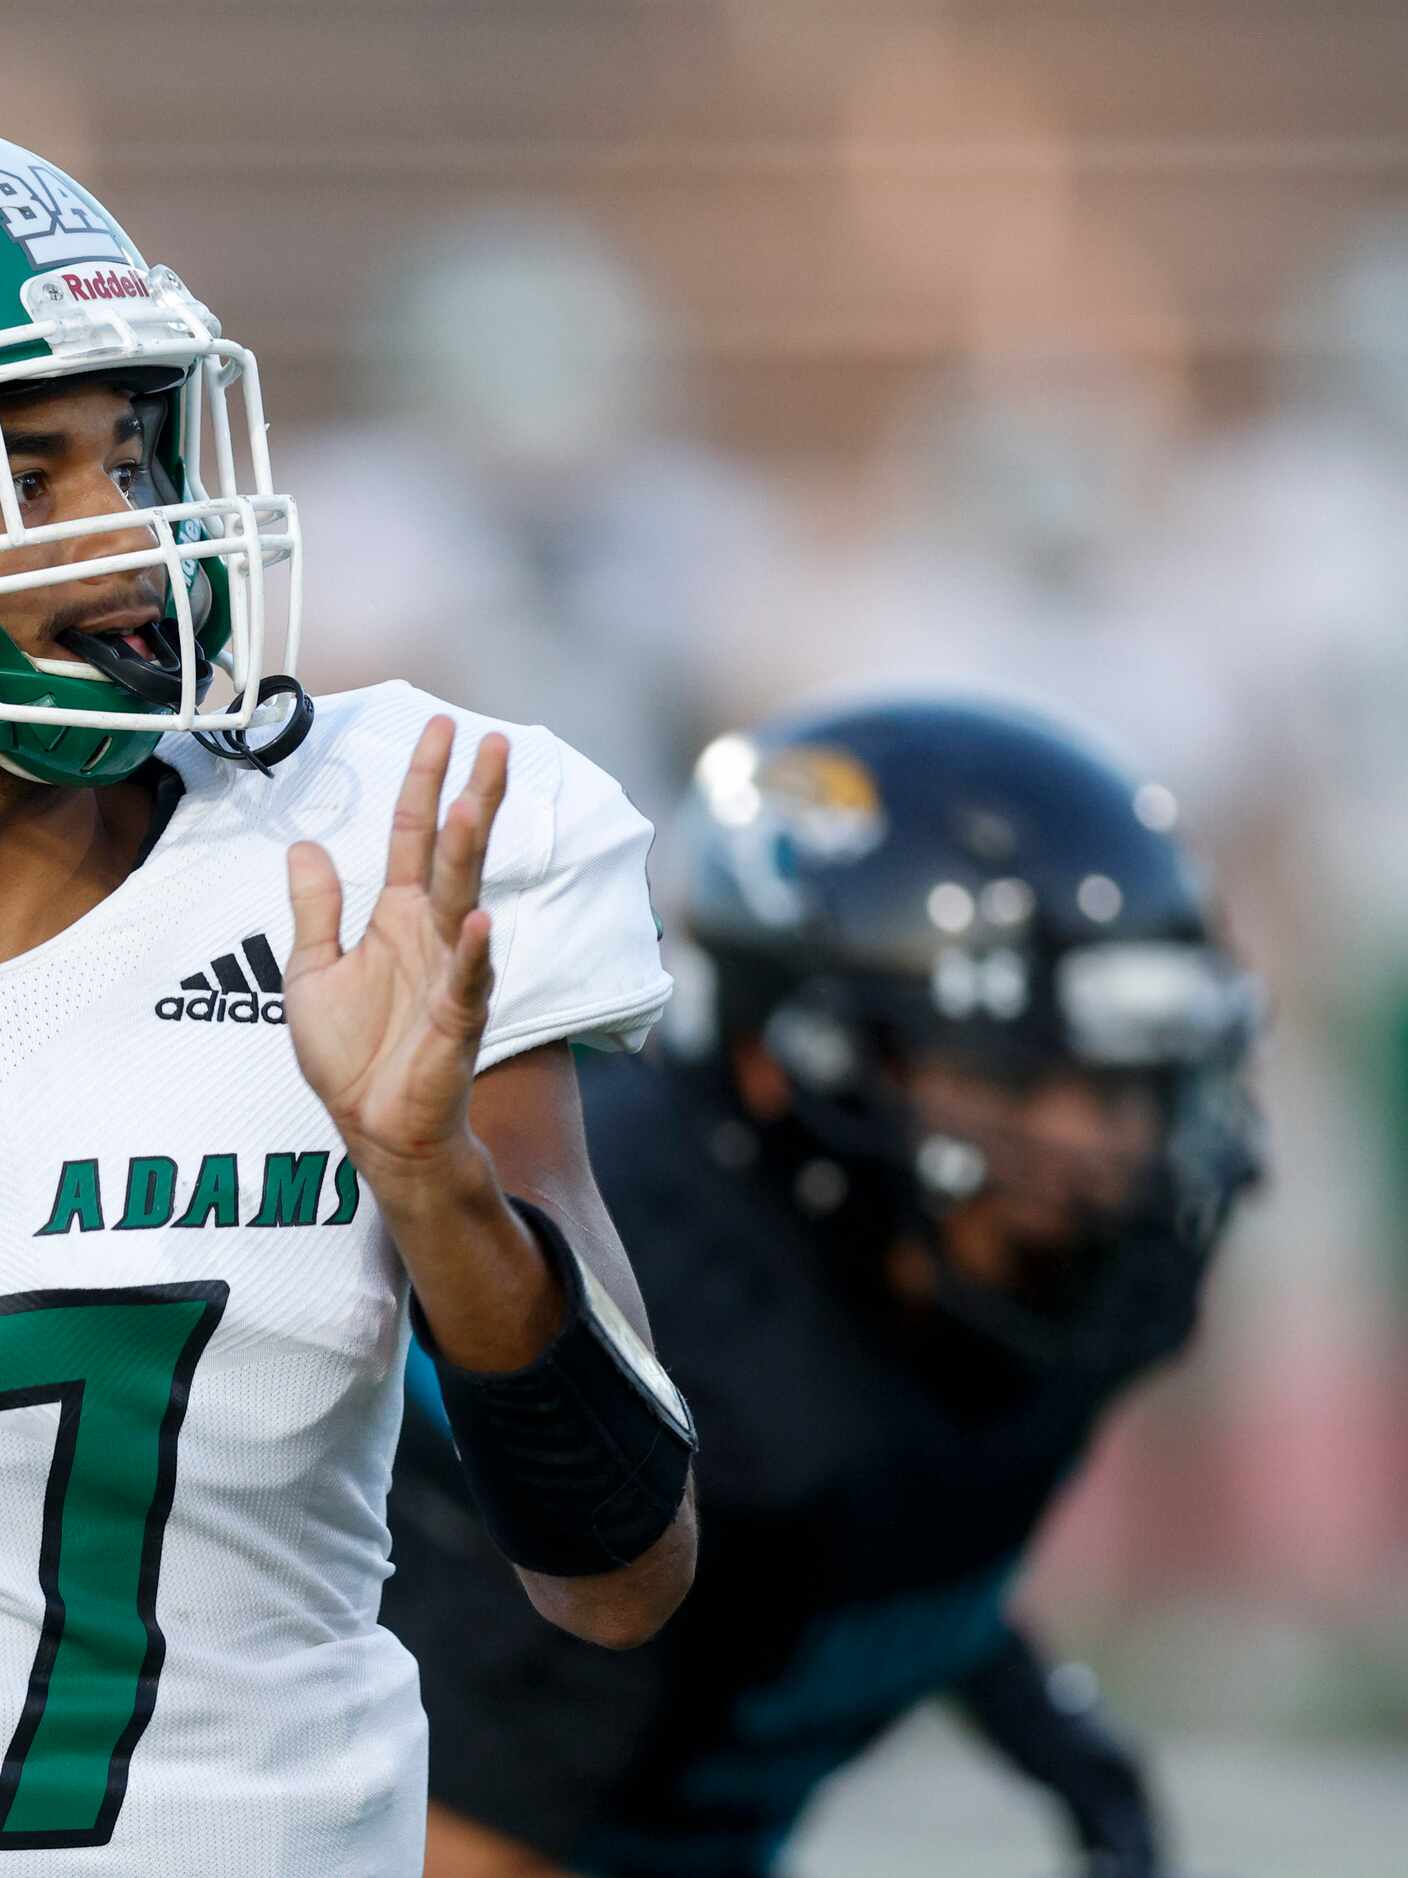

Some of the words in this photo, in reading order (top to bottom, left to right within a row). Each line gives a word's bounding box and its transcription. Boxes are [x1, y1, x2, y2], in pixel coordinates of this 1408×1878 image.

[62, 270, 150, 301] Riddell
[154, 989, 288, 1024] adida
[33, 1151, 360, 1237] ADAMS
